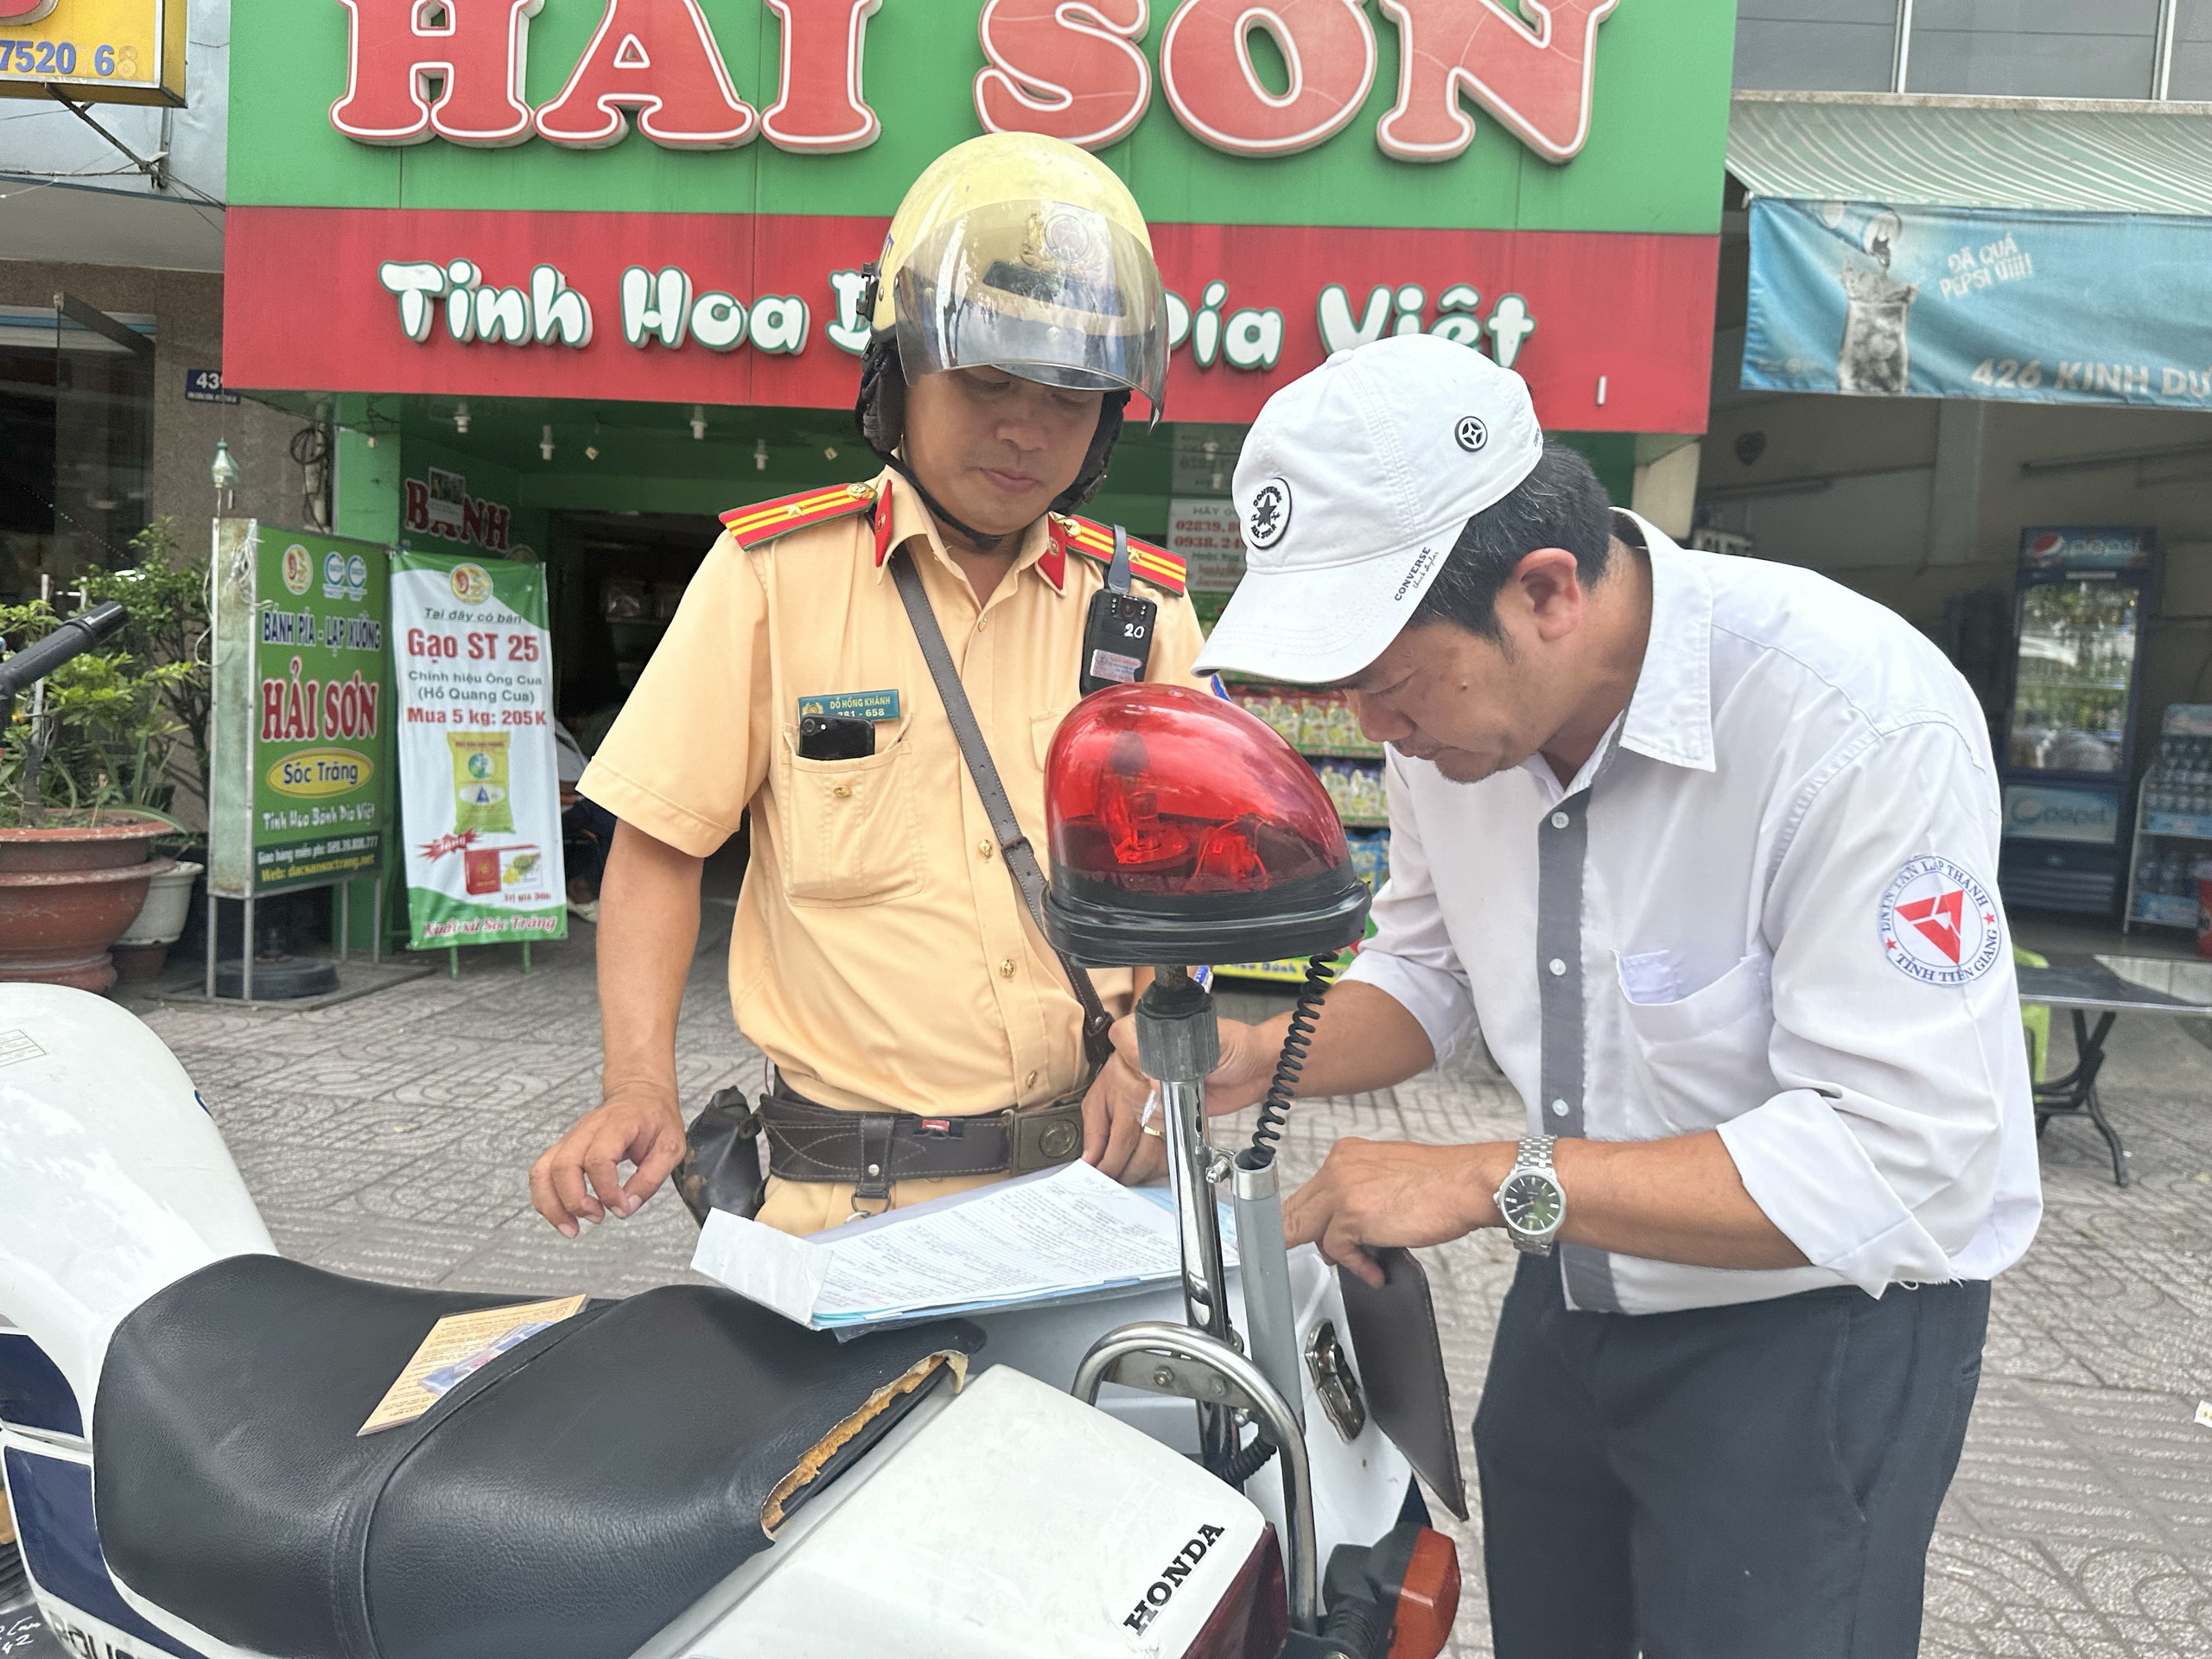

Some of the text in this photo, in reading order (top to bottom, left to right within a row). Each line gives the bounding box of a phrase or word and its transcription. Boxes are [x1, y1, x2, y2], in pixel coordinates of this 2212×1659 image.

[1940, 268, 1992, 298] PEPSI
[378, 258, 593, 348] Tinh
[620, 265, 810, 355] Hoa
[195, 372, 223, 390] 43
[1971, 358, 2042, 389] 426
[2055, 360, 2149, 394] KINH
[1394, 547, 1431, 601] CONVERSE
[262, 602, 295, 645] BÁNH
[477, 613, 493, 623] có
[1124, 623, 1145, 639] 20
[407, 627, 539, 664] Gạo ST 25
[517, 674, 543, 685] Cua
[261, 656, 378, 742] HẢI SƠN
[448, 687, 498, 703] Quang
[501, 690, 535, 704] Cua)
[407, 707, 447, 723] Mua
[452, 709, 463, 724] 5
[469, 709, 497, 726] kg:
[865, 709, 885, 717] 658
[283, 761, 359, 785] Sóc Trăng
[483, 917, 505, 932] Sóc
[511, 914, 557, 933] Trăng
[1974, 929, 1998, 972] GIANG
[1122, 1523, 1225, 1637] HONDA
